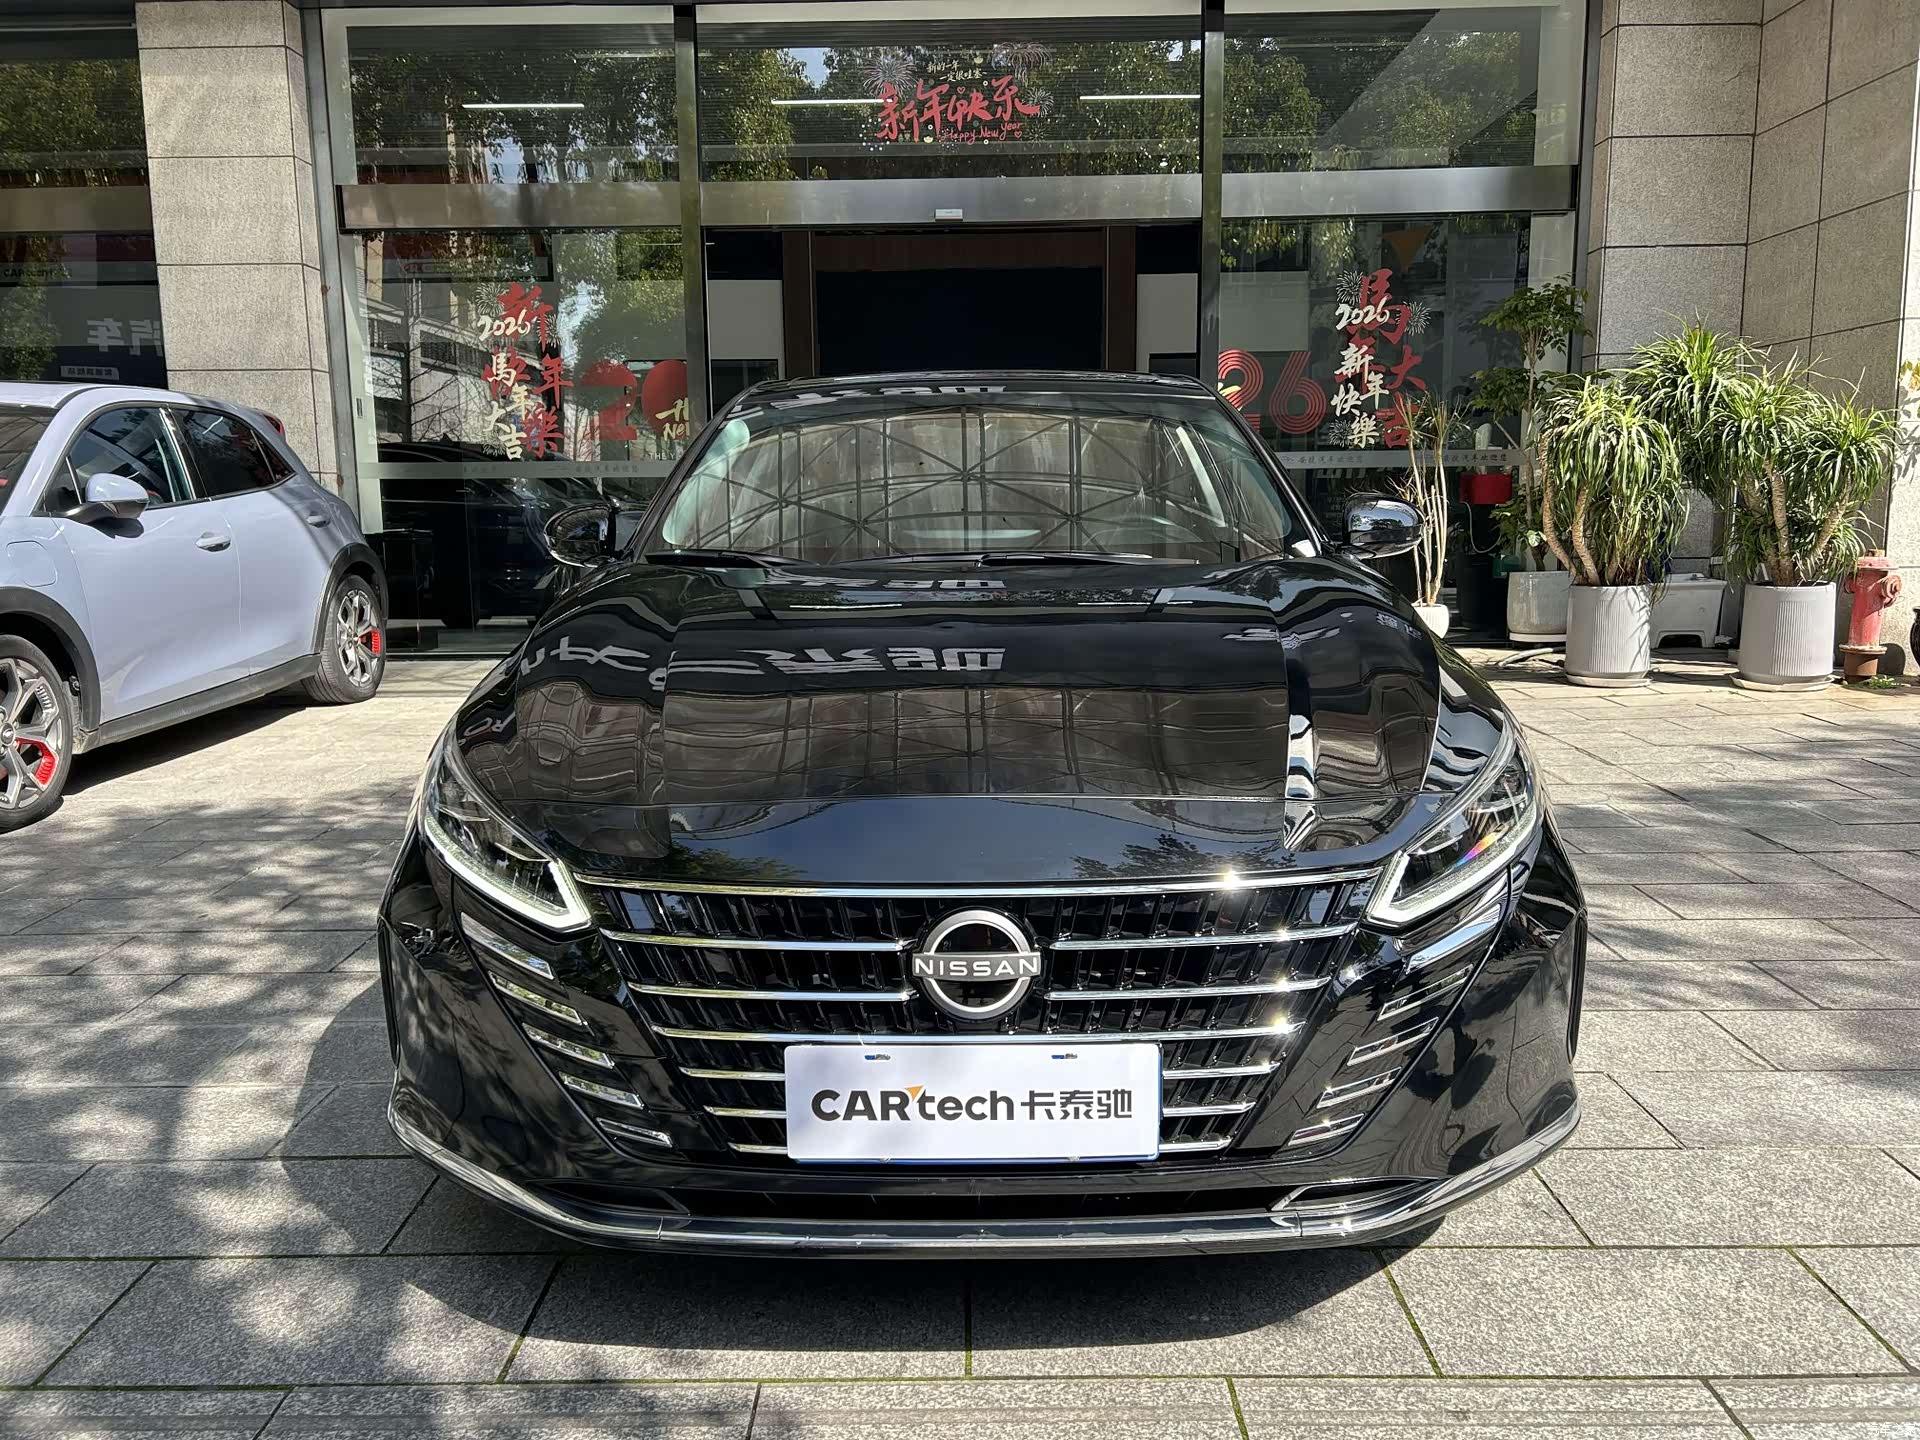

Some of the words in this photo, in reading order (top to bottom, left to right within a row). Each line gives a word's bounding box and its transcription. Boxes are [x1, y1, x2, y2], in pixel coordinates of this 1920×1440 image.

[926, 60, 960, 75] 新的一年
[874, 75, 1041, 143] 新年快乐
[980, 125, 998, 138] New
[477, 308, 533, 341] 2026
[1335, 295, 1390, 330] 2026
[914, 957, 1040, 977] NISSAN
[811, 1086, 1015, 1122] CARtech
[1020, 1089, 1133, 1120] 卡泰驰
